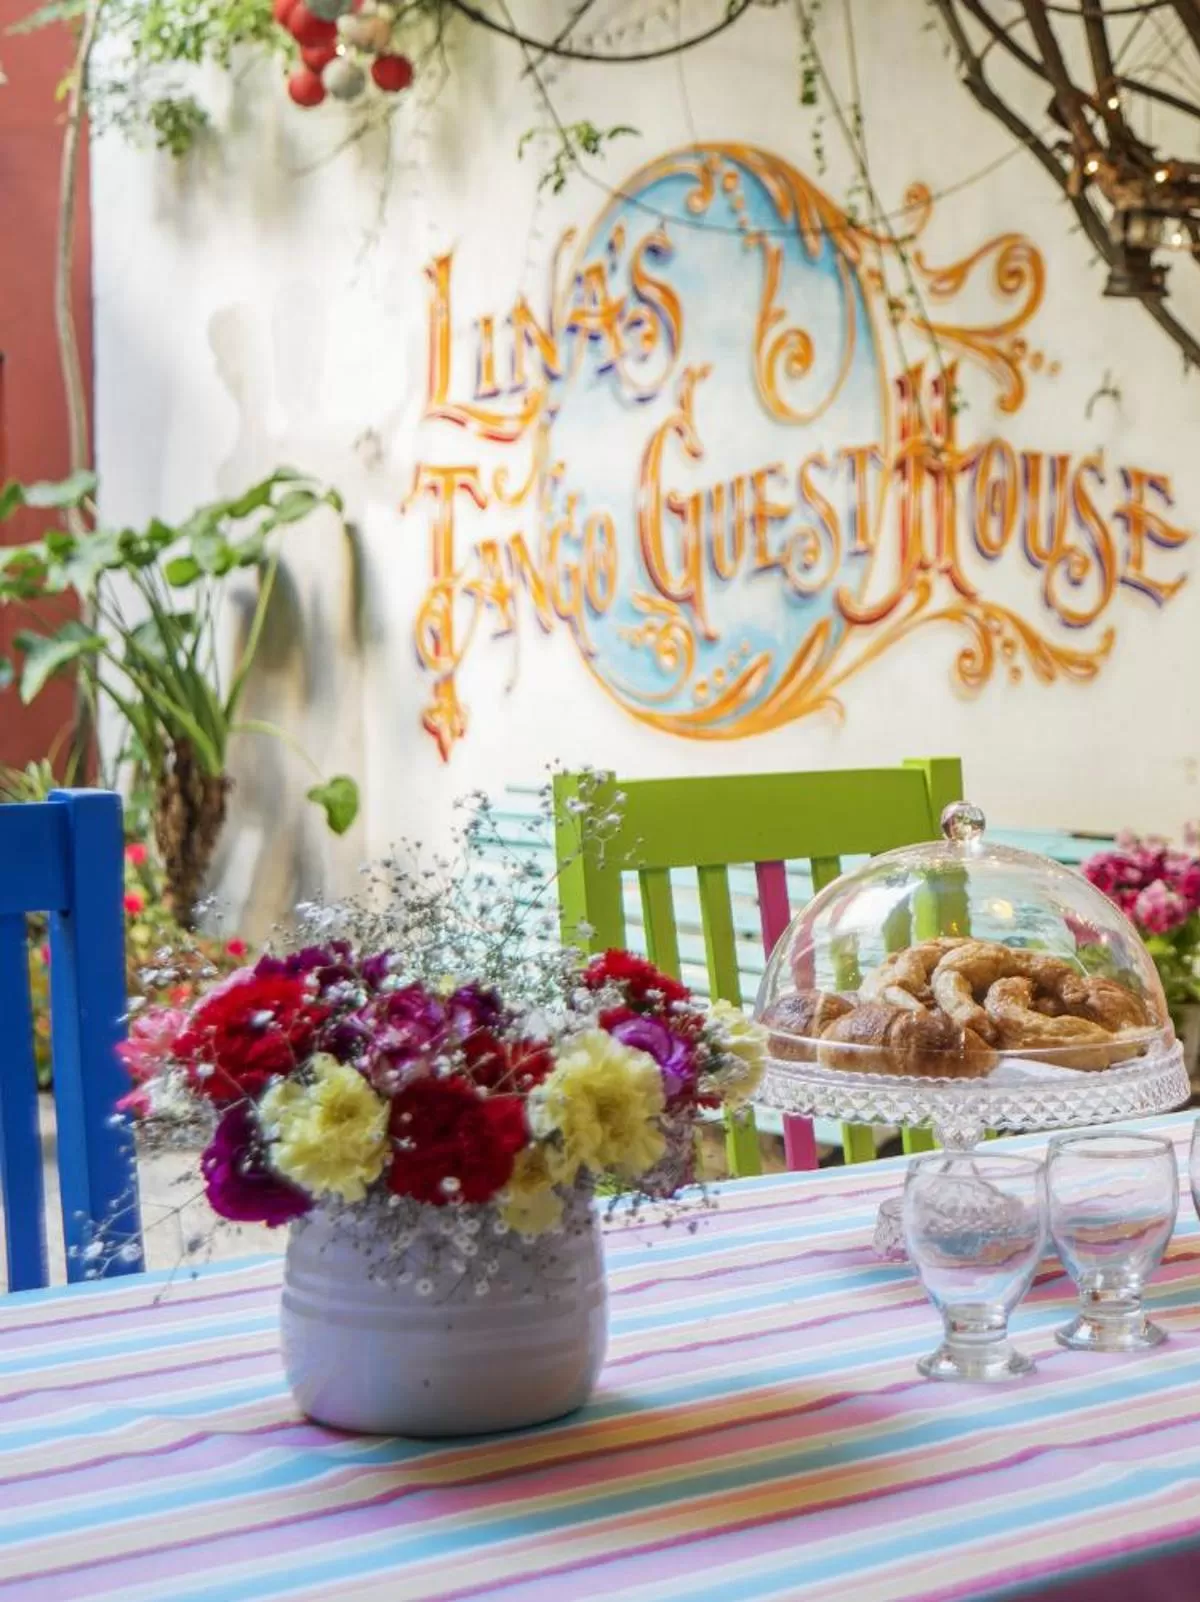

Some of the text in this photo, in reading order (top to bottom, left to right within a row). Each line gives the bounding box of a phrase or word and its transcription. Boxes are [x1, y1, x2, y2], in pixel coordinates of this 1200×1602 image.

[422, 222, 683, 443] LINA'S
[400, 361, 1195, 763] TANGO GUEST HOUSE
